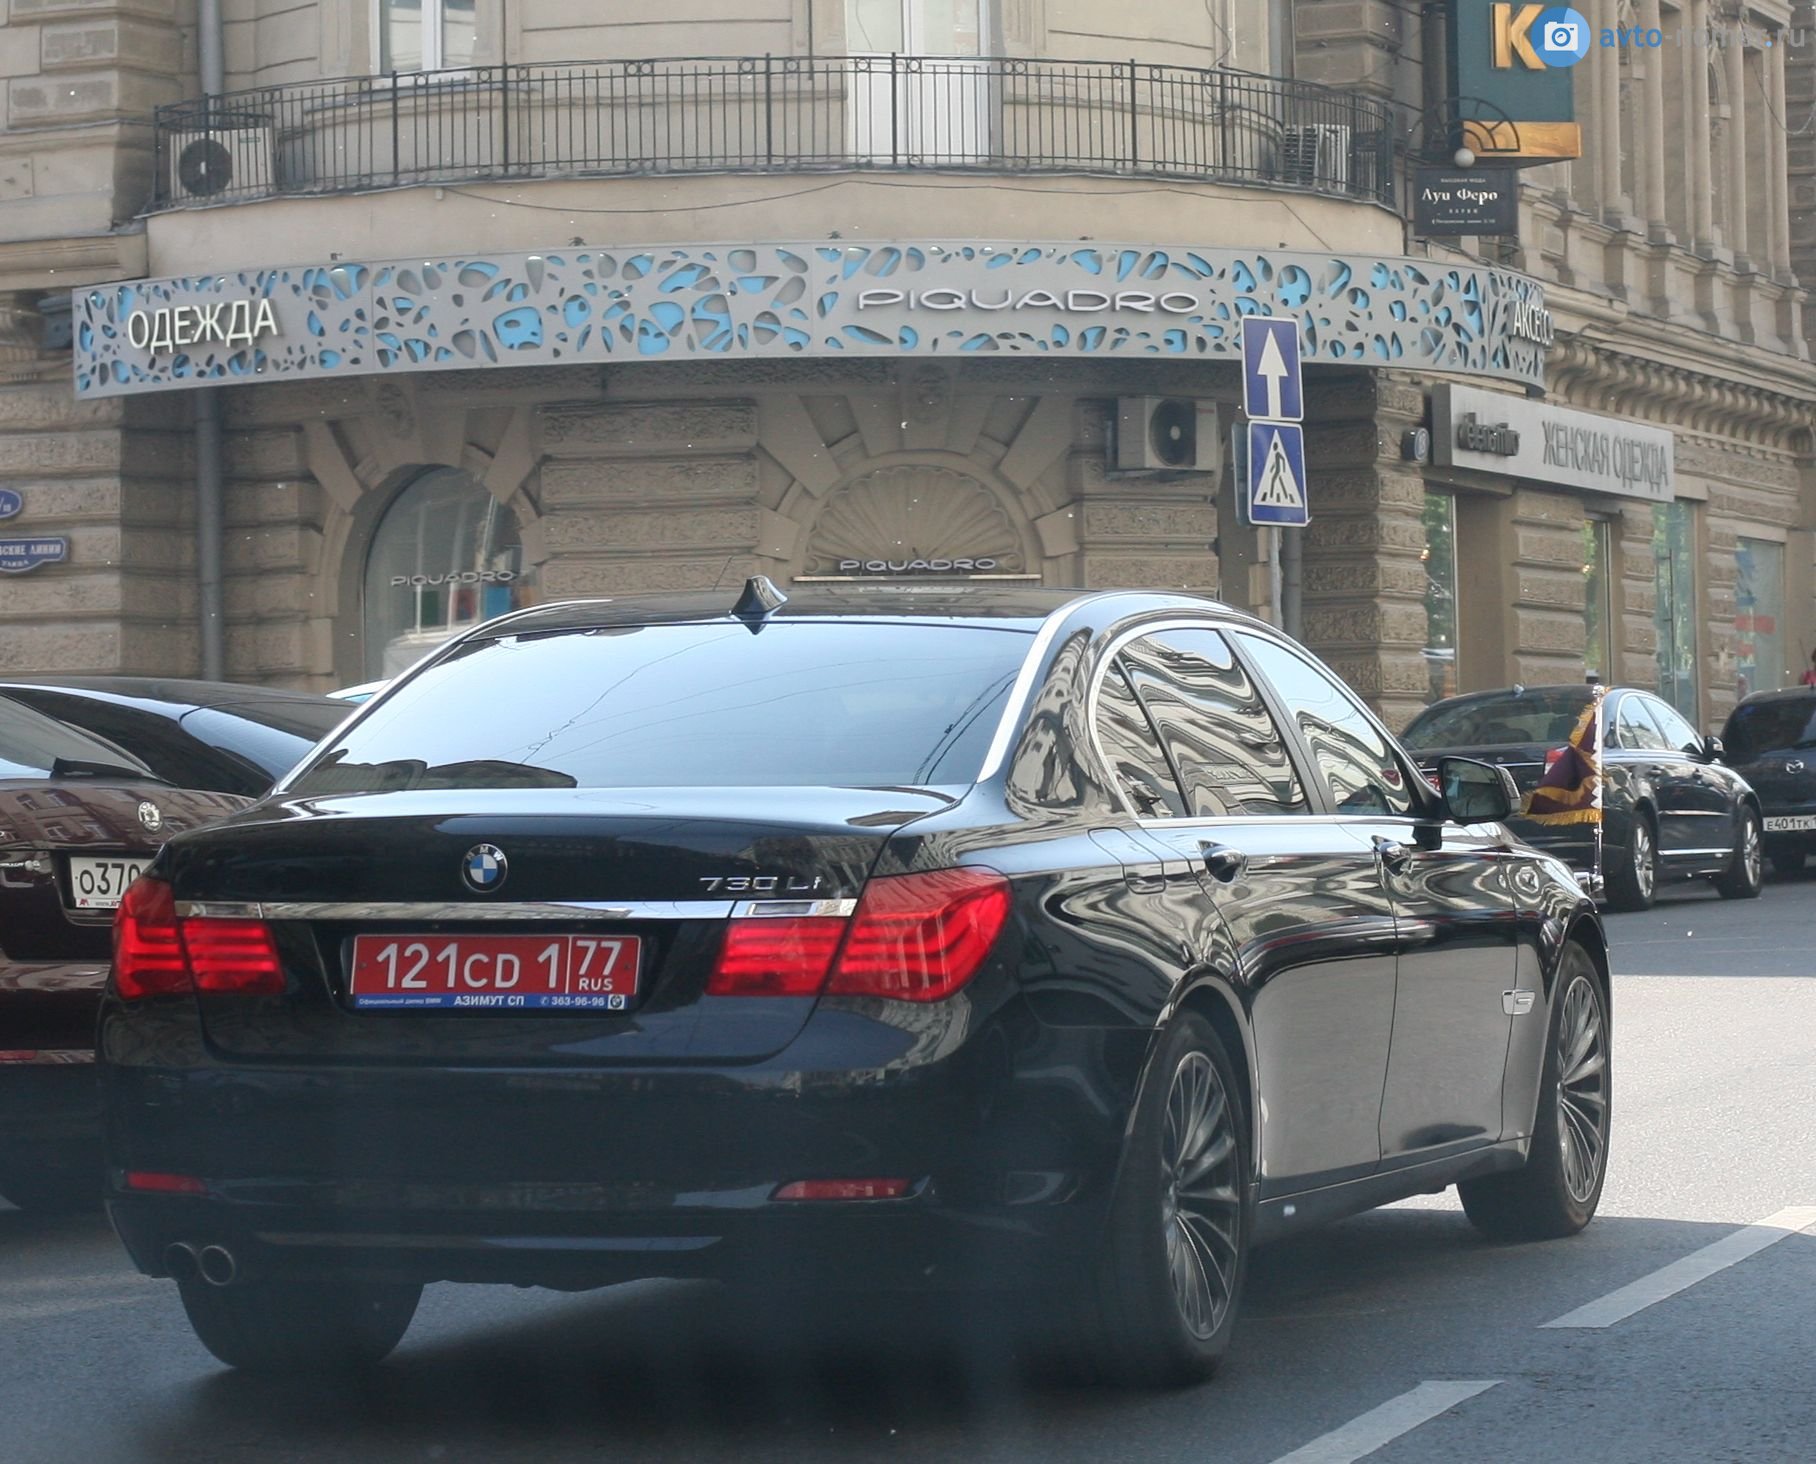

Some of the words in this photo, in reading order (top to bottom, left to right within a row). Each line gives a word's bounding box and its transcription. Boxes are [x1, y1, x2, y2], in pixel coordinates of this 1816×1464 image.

[1422, 188, 1450, 205] Луи
[1457, 188, 1498, 205] Феро
[858, 288, 1199, 313] PIQUADRO
[128, 298, 279, 355] ОДЕЖДА
[1542, 420, 1610, 477] ЖЕНСКАЯ
[1612, 434, 1669, 494] ОДЕЖДА
[840, 558, 996, 571] PIQUADRO
[391, 570, 514, 586] PIQUADRO
[575, 940, 623, 976] 77
[578, 977, 613, 991] RUS
[453, 996, 504, 1006] АЗИМУТ
[506, 995, 525, 1006] СП
